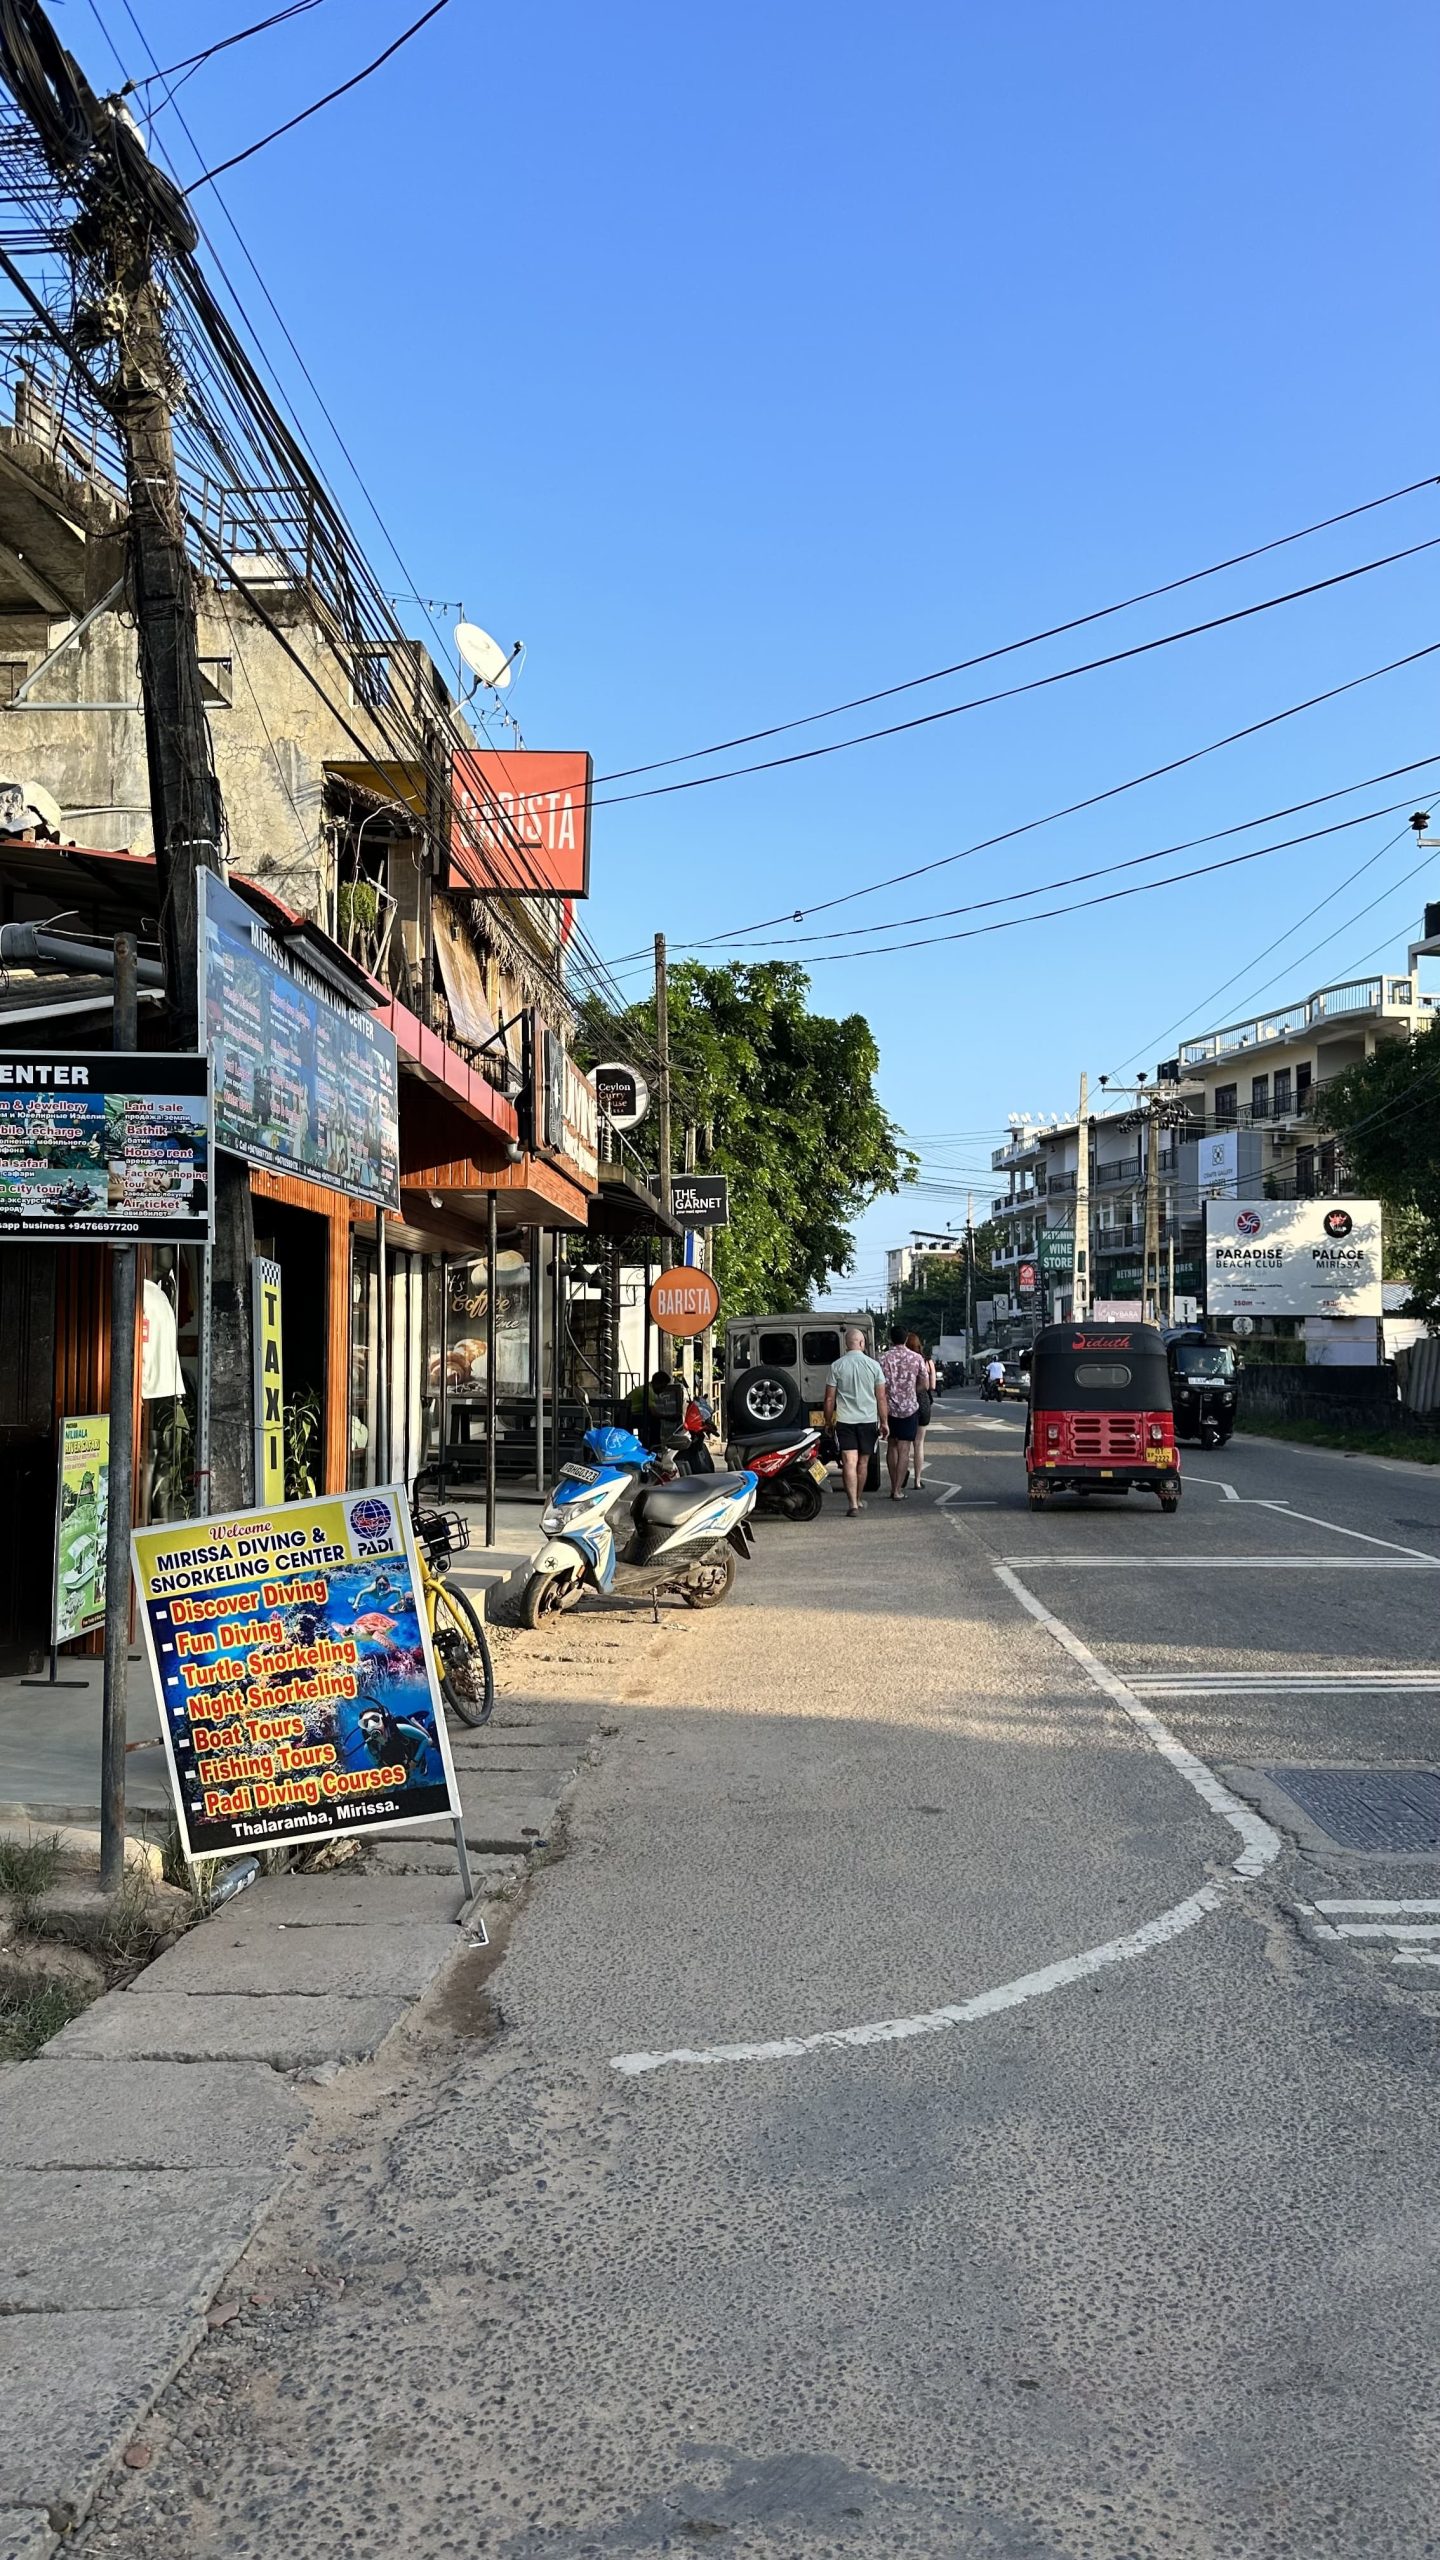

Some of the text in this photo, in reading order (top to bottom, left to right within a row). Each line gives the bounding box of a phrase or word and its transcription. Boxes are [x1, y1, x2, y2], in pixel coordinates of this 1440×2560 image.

[250, 921, 290, 975] MIRISSA
[293, 958, 347, 1020] INFORMATION
[348, 1007, 374, 1042] CENTER
[0, 1065, 89, 1085] ENTER
[598, 1082, 631, 1093] Ceylon
[598, 1091, 626, 1101] Curry
[13, 1100, 24, 1111] &
[26, 1100, 88, 1114] Jewellery
[124, 1101, 184, 1112] Land sale
[0, 1125, 84, 1139] bile recharge
[126, 1125, 167, 1136] Bathik
[125, 1147, 194, 1159] House rent
[13, 1158, 48, 1168] safari
[125, 1170, 208, 1182] Factory shoping
[9, 1184, 32, 1197] city
[36, 1185, 61, 1194] tour
[124, 1181, 146, 1189] tour
[674, 1188, 697, 1200] THE
[0, 1205, 24, 1213] ороду
[123, 1199, 180, 1209] Air ticket
[675, 1197, 722, 1209] GARNET
[0, 1222, 140, 1232] sapp business +94766977200
[1049, 1243, 1073, 1255] WINE
[1215, 1249, 1283, 1259] PARADISE
[1312, 1249, 1364, 1260] PALACE
[1043, 1257, 1073, 1269] STORE
[1215, 1260, 1283, 1269] BEACH CLUB
[1316, 1260, 1361, 1269] MIRISSA
[658, 1288, 711, 1316] BARISTA
[264, 1290, 280, 1470] TAXI
[210, 1522, 272, 1541] Welcome
[157, 1527, 326, 1572] MIRISSA DIVING &
[358, 1538, 394, 1556] PADI
[151, 1545, 346, 1593] SNORKELING CENTER
[171, 1580, 327, 1624] Discover Diving
[178, 1621, 283, 1655] Fun Diving
[182, 1641, 356, 1686] Turtle Snorkeling
[188, 1674, 356, 1720] Night Snorkeling
[195, 1717, 303, 1750] Boat Tours
[200, 1745, 334, 1783] Fishing Tours
[206, 1766, 405, 1815] Padi Diving Courses
[232, 1801, 400, 1838] Thalaramba, Mirissa.
